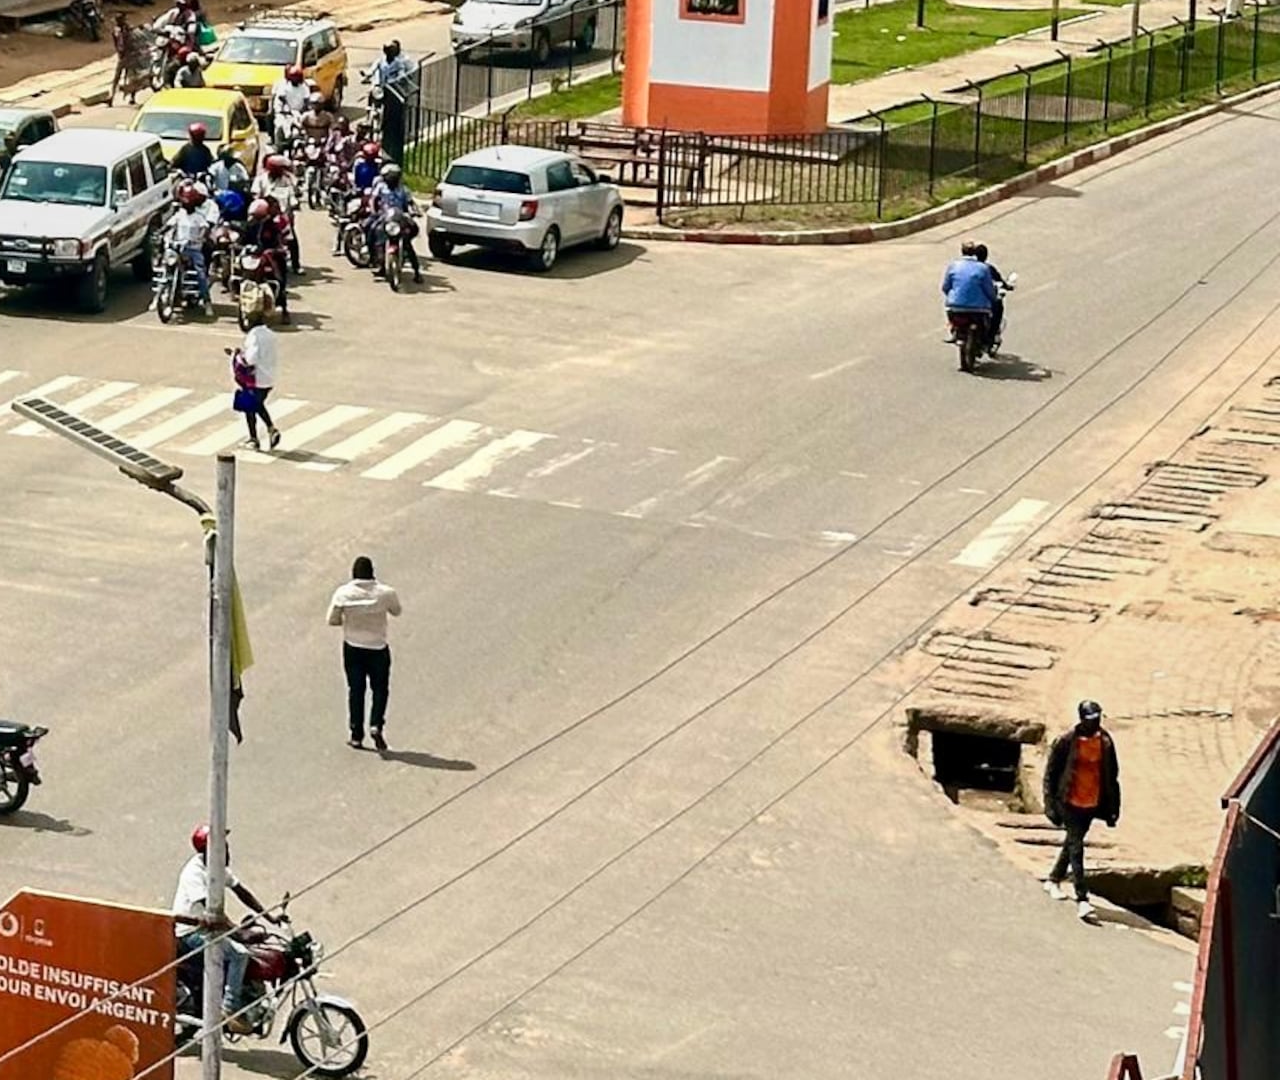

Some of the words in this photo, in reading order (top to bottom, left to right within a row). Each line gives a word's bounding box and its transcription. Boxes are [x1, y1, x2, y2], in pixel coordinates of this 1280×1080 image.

[34, 983, 86, 1010] ENVOI
[89, 997, 159, 1026] ARGENT
[42, 965, 155, 1005] INSUFFISANT
